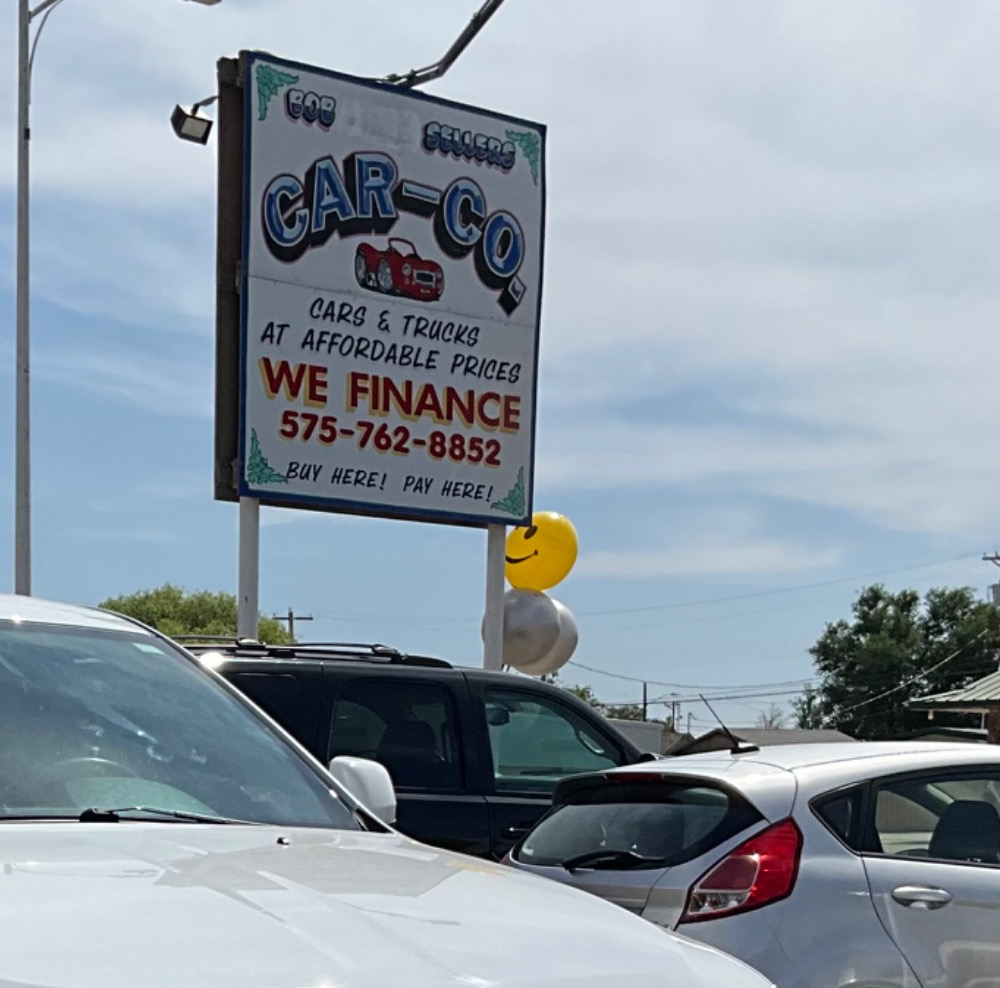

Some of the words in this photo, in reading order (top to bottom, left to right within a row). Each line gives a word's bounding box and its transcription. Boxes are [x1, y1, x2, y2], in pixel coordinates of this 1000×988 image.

[285, 88, 336, 131] BOB
[422, 121, 516, 174] SELLERS
[309, 297, 367, 328] CARS
[378, 309, 391, 333] &
[403, 314, 480, 347] TRUCKS
[261, 321, 290, 346] AT
[301, 328, 440, 370] AFFORDABLE
[450, 353, 522, 384] PRICES
[258, 356, 329, 407] WE
[346, 371, 522, 434] FINANCE
[279, 410, 502, 467] 575-762-8852
[286, 461, 323, 482] BUY
[331, 467, 388, 490] HERE!
[403, 475, 435, 495] PAY
[441, 481, 494, 502] HERE!
